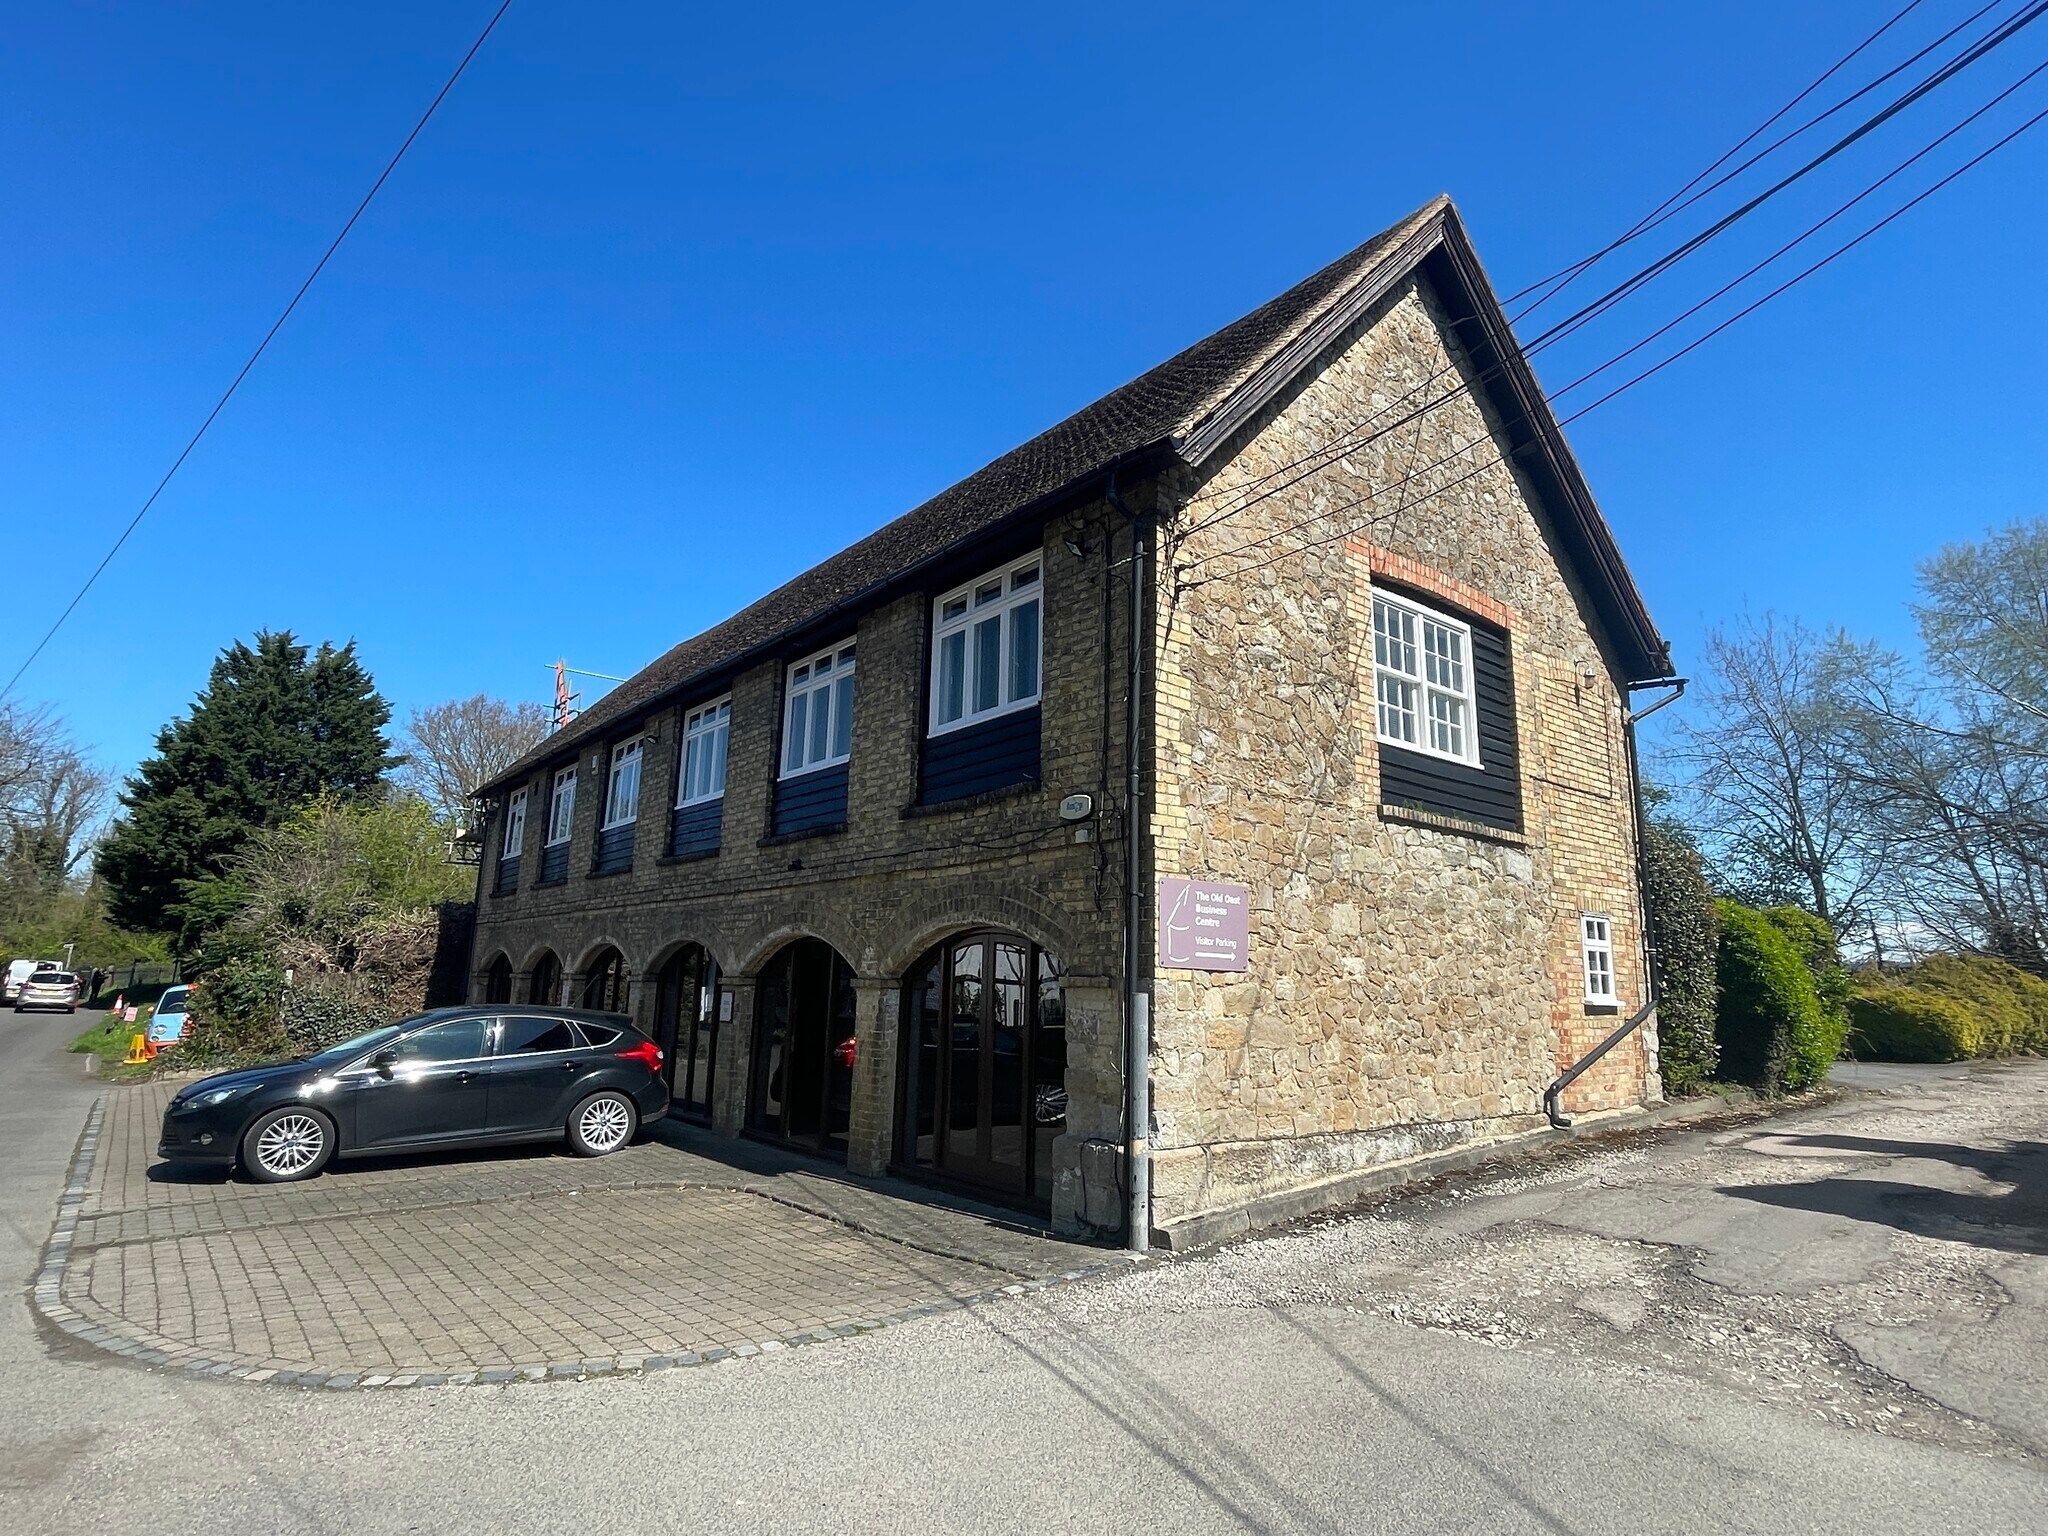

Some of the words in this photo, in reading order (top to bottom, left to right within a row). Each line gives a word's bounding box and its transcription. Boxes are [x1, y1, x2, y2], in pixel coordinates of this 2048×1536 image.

[1195, 890, 1210, 901] The
[1210, 893, 1223, 902] Old
[1225, 894, 1240, 904] Oast
[1195, 903, 1227, 915] Business
[1195, 916, 1220, 927] Centre
[1195, 936, 1214, 945] Visitor
[1215, 937, 1237, 949] Parking
